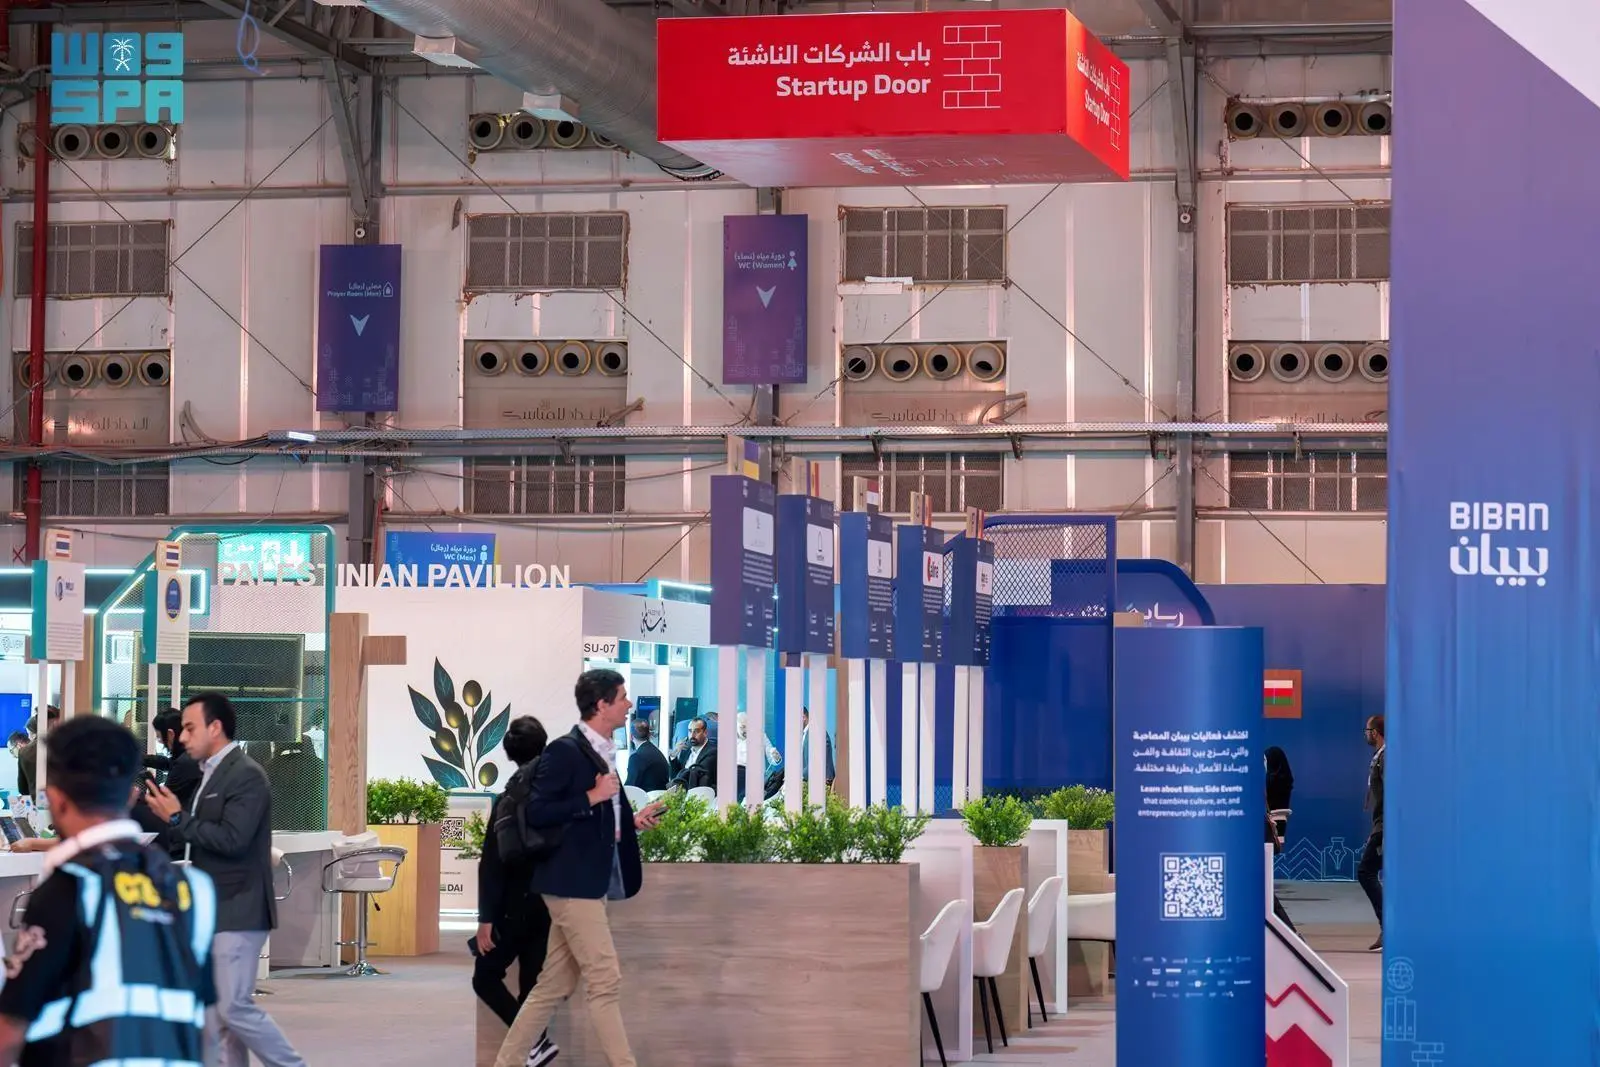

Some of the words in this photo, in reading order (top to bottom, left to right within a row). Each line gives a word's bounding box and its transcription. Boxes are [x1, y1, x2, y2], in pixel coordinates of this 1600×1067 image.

[728, 43, 798, 66] الناشئة
[803, 41, 890, 68] الشركات
[895, 42, 931, 67] باب
[776, 76, 868, 101] Startup
[874, 74, 931, 94] Door
[752, 260, 786, 270] (Women)
[1450, 501, 1549, 531] BIBAN
[450, 544, 462, 554] مياه
[463, 545, 477, 554] دورة
[456, 553, 476, 562] (Men)
[1449, 533, 1549, 587] بيبان
[428, 563, 571, 588] PAVILION
[583, 642, 616, 654] SU-07
[1170, 730, 1190, 743] بيبان
[1191, 730, 1222, 743] فعاليات
[1222, 729, 1249, 740] اكتشف
[1140, 784, 1161, 793] Learn
[1161, 784, 1182, 793] about
[1183, 784, 1204, 793] Biban
[1204, 784, 1220, 793] Side
[1220, 784, 1243, 793] Events
[1143, 797, 1158, 805] that
[1158, 797, 1189, 805] combine
[1189, 797, 1216, 806] culture,
[1228, 796, 1241, 805] and
[1137, 809, 1197, 819] entrepreneurship
[1198, 809, 1206, 817] all
[1206, 809, 1214, 817] in
[447, 883, 464, 893] DAI
